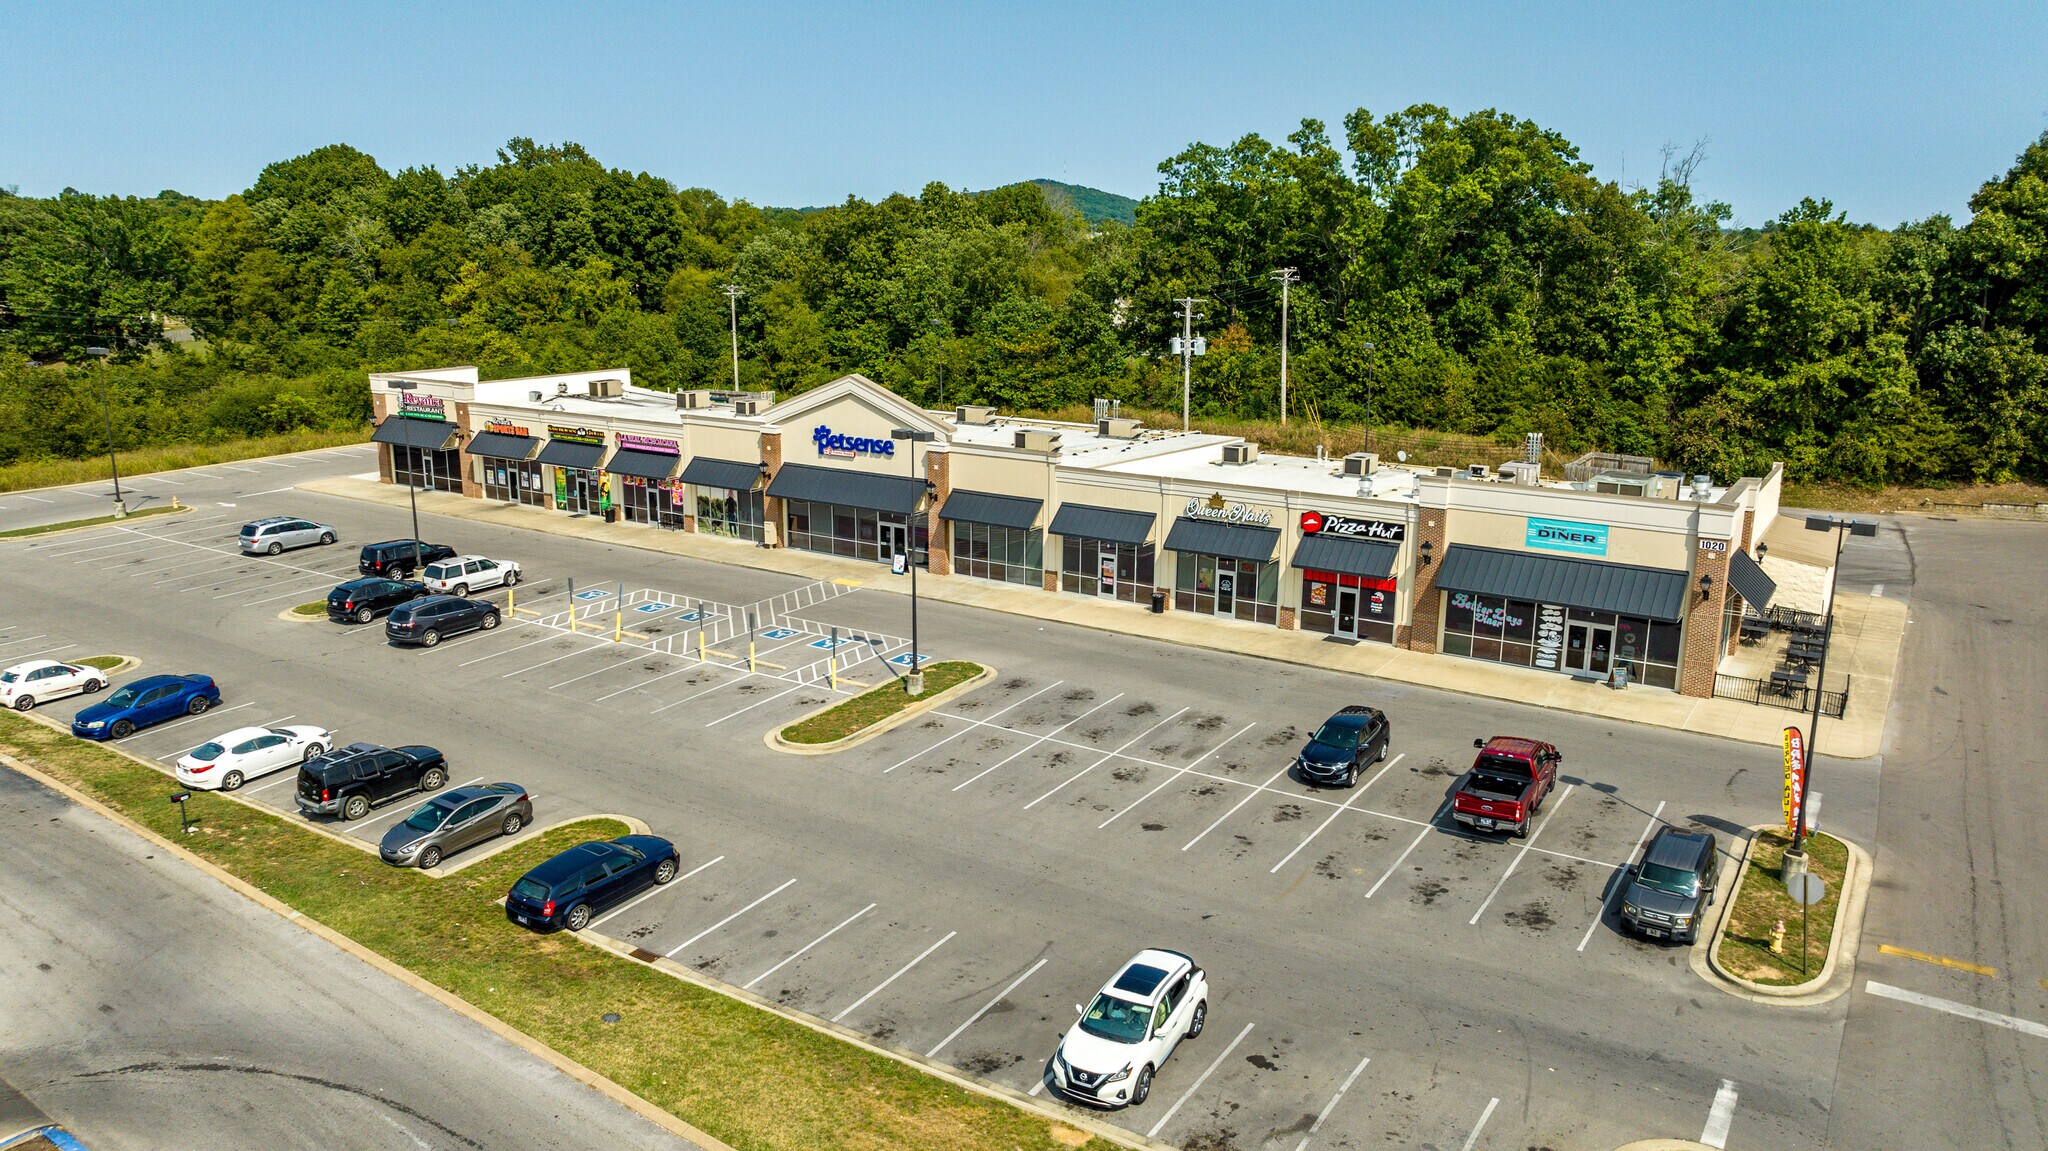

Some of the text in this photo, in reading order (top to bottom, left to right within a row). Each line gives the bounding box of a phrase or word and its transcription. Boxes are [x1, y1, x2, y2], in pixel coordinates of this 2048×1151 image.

[404, 393, 443, 407] Revaira
[407, 406, 443, 414] RESTAURANT
[493, 423, 529, 437] SPORTS BAR
[815, 430, 895, 456] petsense
[1187, 497, 1272, 525] Queen Nails
[1323, 516, 1403, 539] Pizza Hut
[1538, 529, 1596, 543] DINER
[1702, 540, 1725, 551] 1020
[1451, 593, 1523, 627] Better Days
[1475, 613, 1503, 628] Diner
